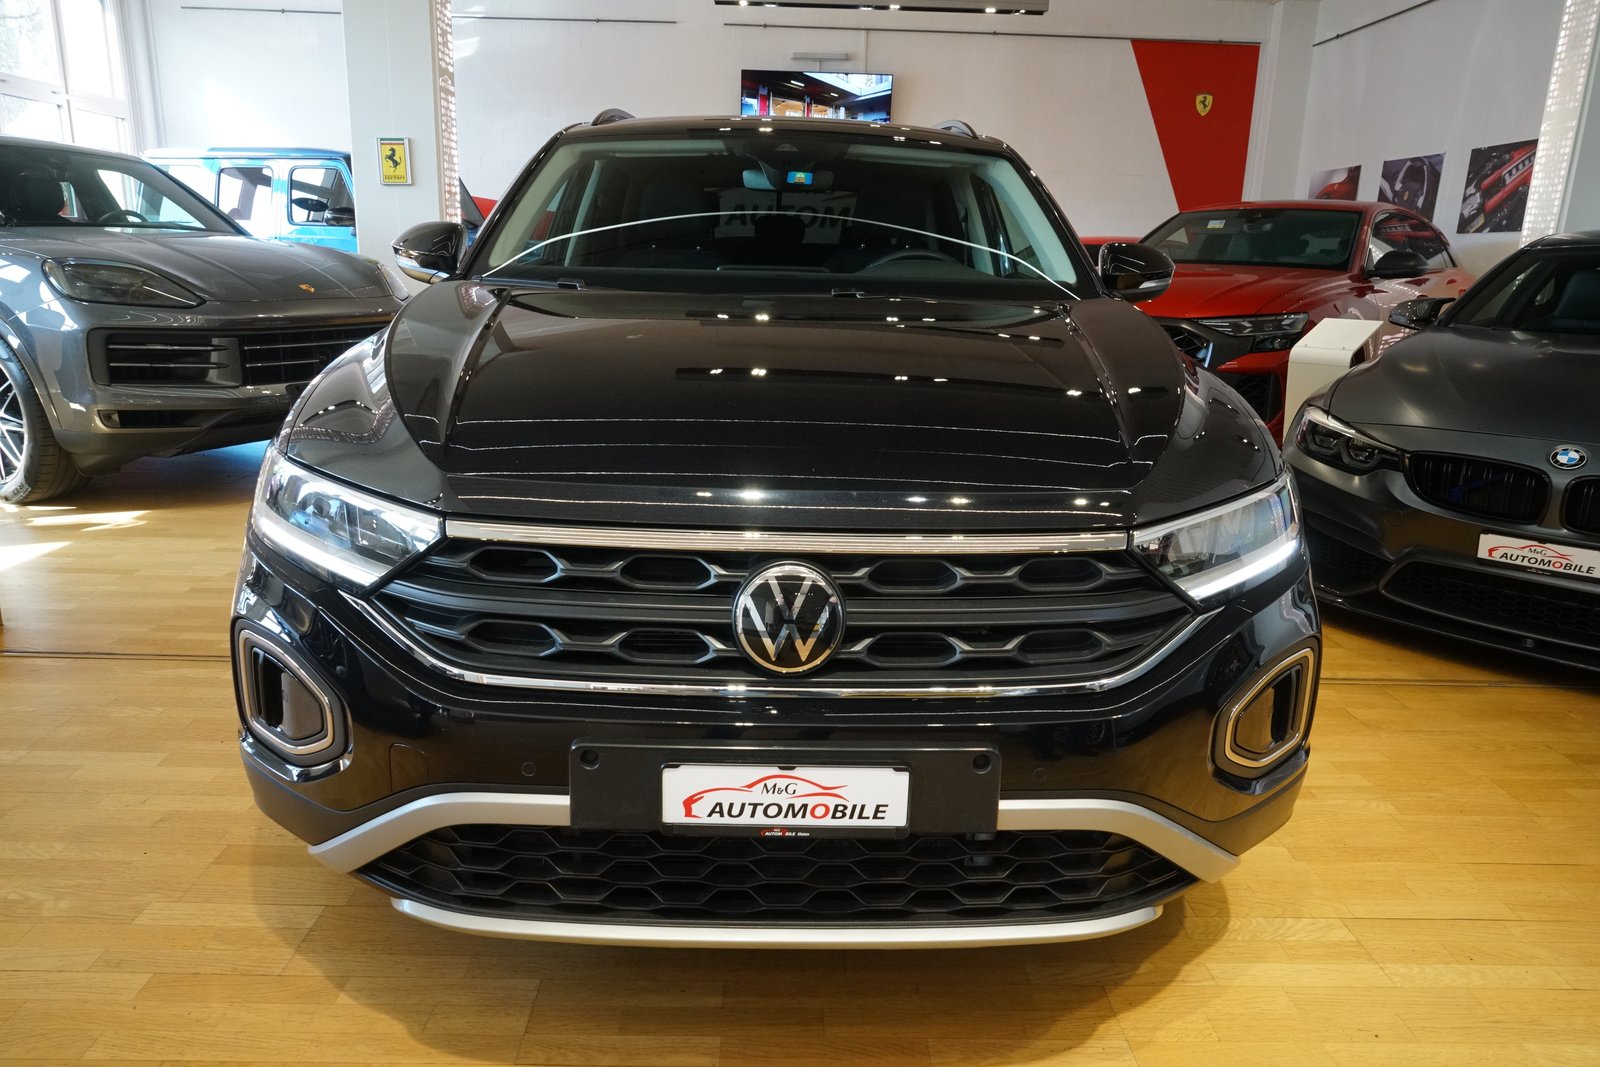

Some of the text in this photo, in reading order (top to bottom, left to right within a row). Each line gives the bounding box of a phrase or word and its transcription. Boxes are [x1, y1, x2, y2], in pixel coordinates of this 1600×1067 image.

[1528, 547, 1547, 556] M&G
[1499, 552, 1596, 575] AUTOMOBILE
[741, 566, 838, 662] VW
[761, 782, 798, 796] M&G
[707, 802, 889, 820] AUTOMOBILE
